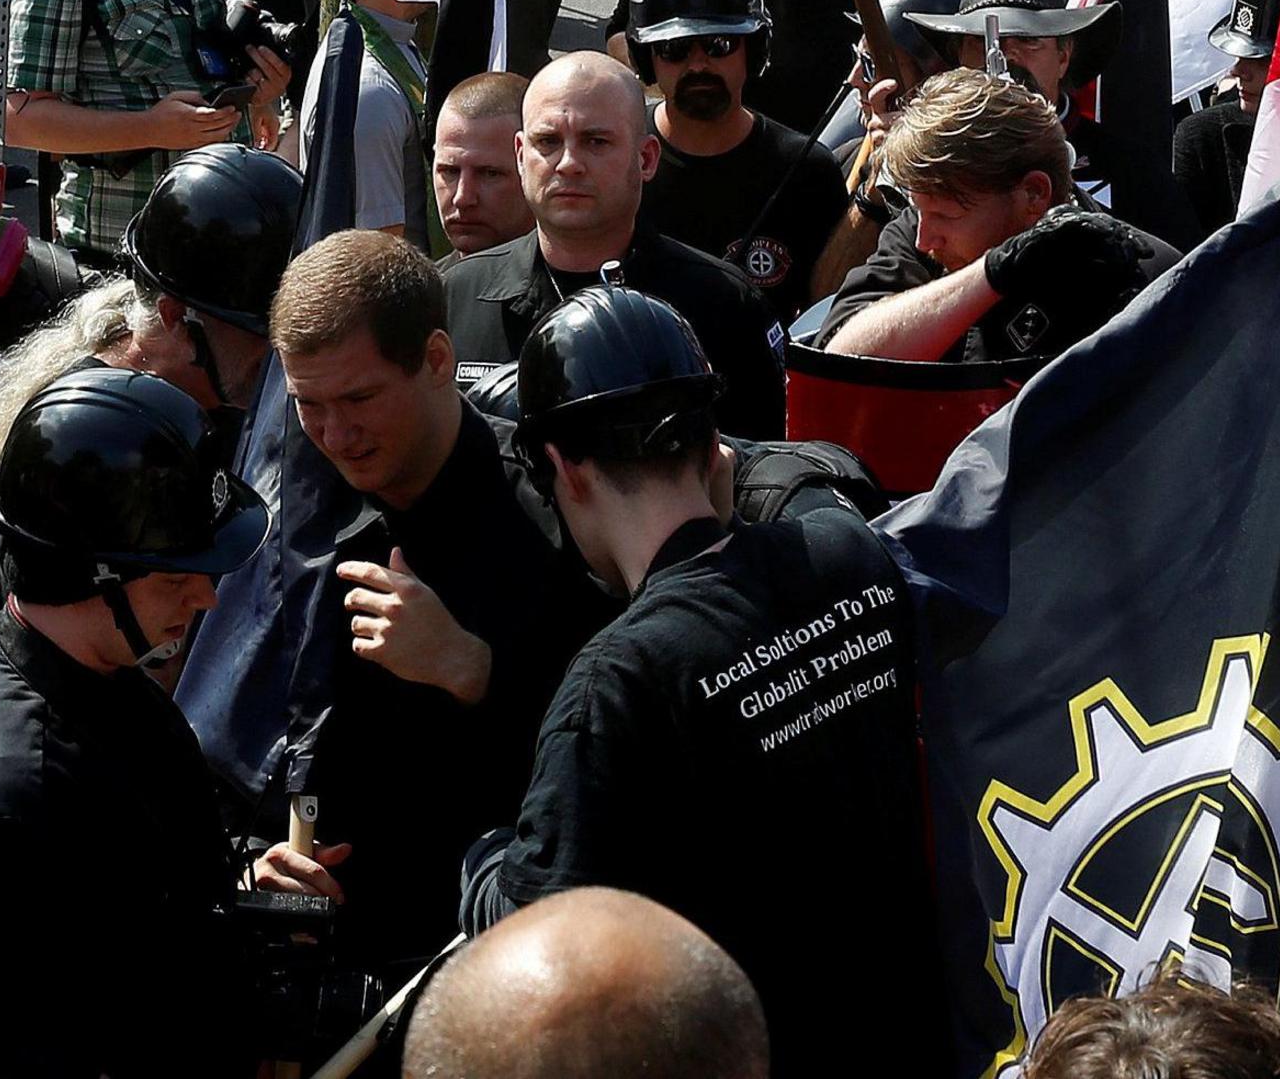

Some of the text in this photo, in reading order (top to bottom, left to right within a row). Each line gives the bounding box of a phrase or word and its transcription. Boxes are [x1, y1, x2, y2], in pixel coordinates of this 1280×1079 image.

[698, 652, 758, 699] Local
[834, 599, 864, 621] To
[862, 584, 896, 609] The
[809, 628, 893, 679] Problem
